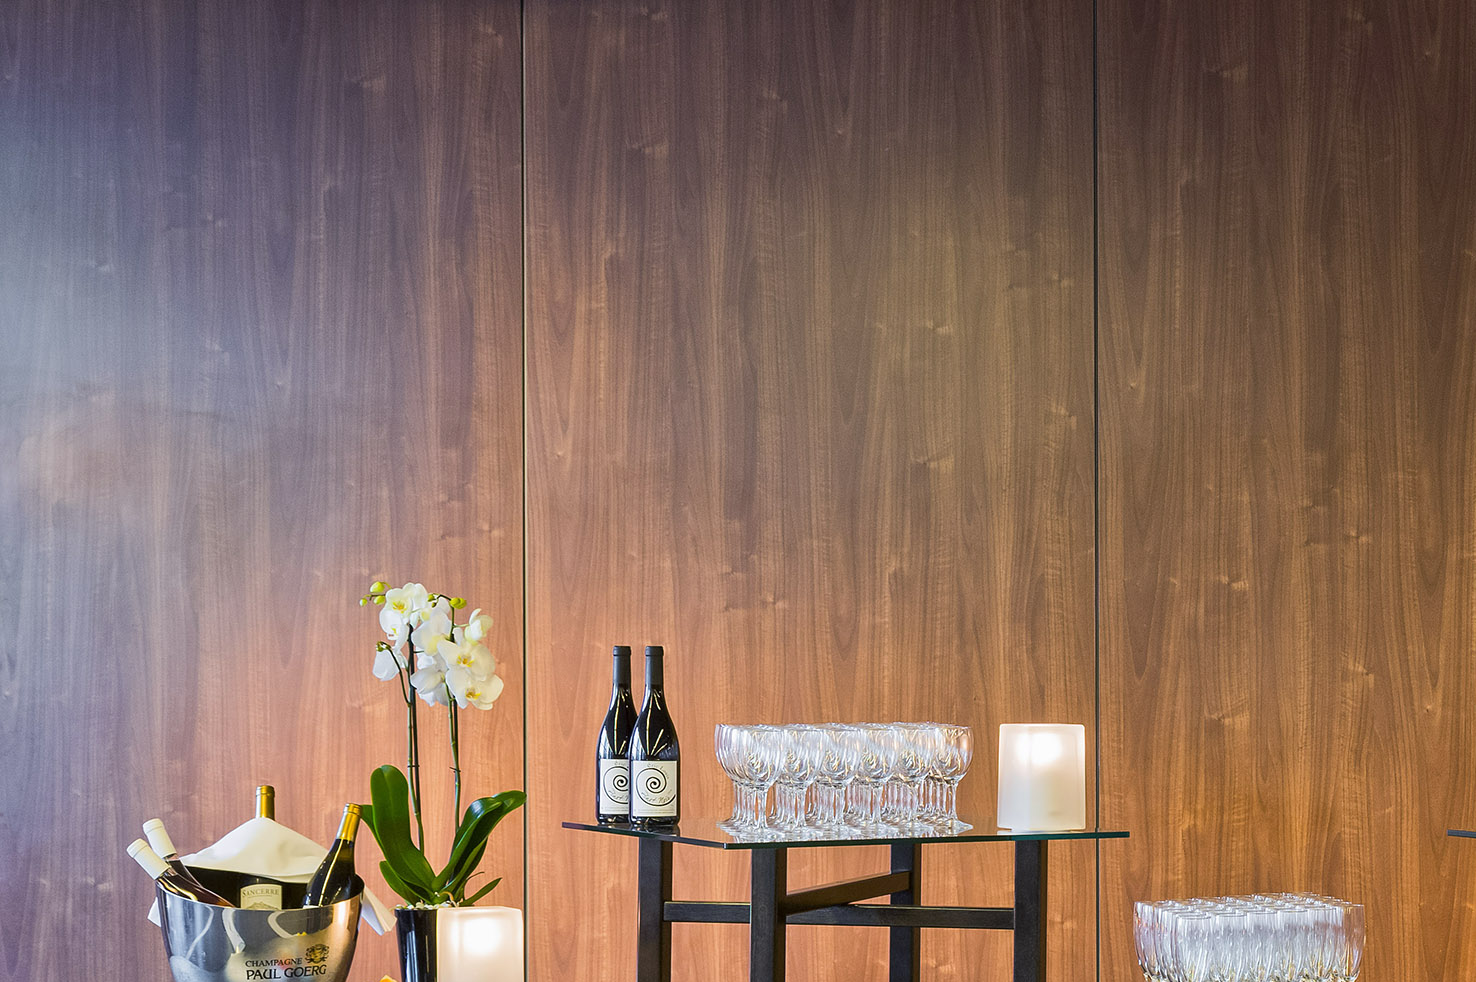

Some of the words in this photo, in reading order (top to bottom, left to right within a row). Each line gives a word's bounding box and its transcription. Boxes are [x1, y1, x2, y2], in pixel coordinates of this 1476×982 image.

[242, 889, 279, 897] SANCERRE
[245, 958, 303, 967] CHAMPAGNE
[246, 969, 281, 980] PAUL
[284, 964, 327, 978] GOERG
